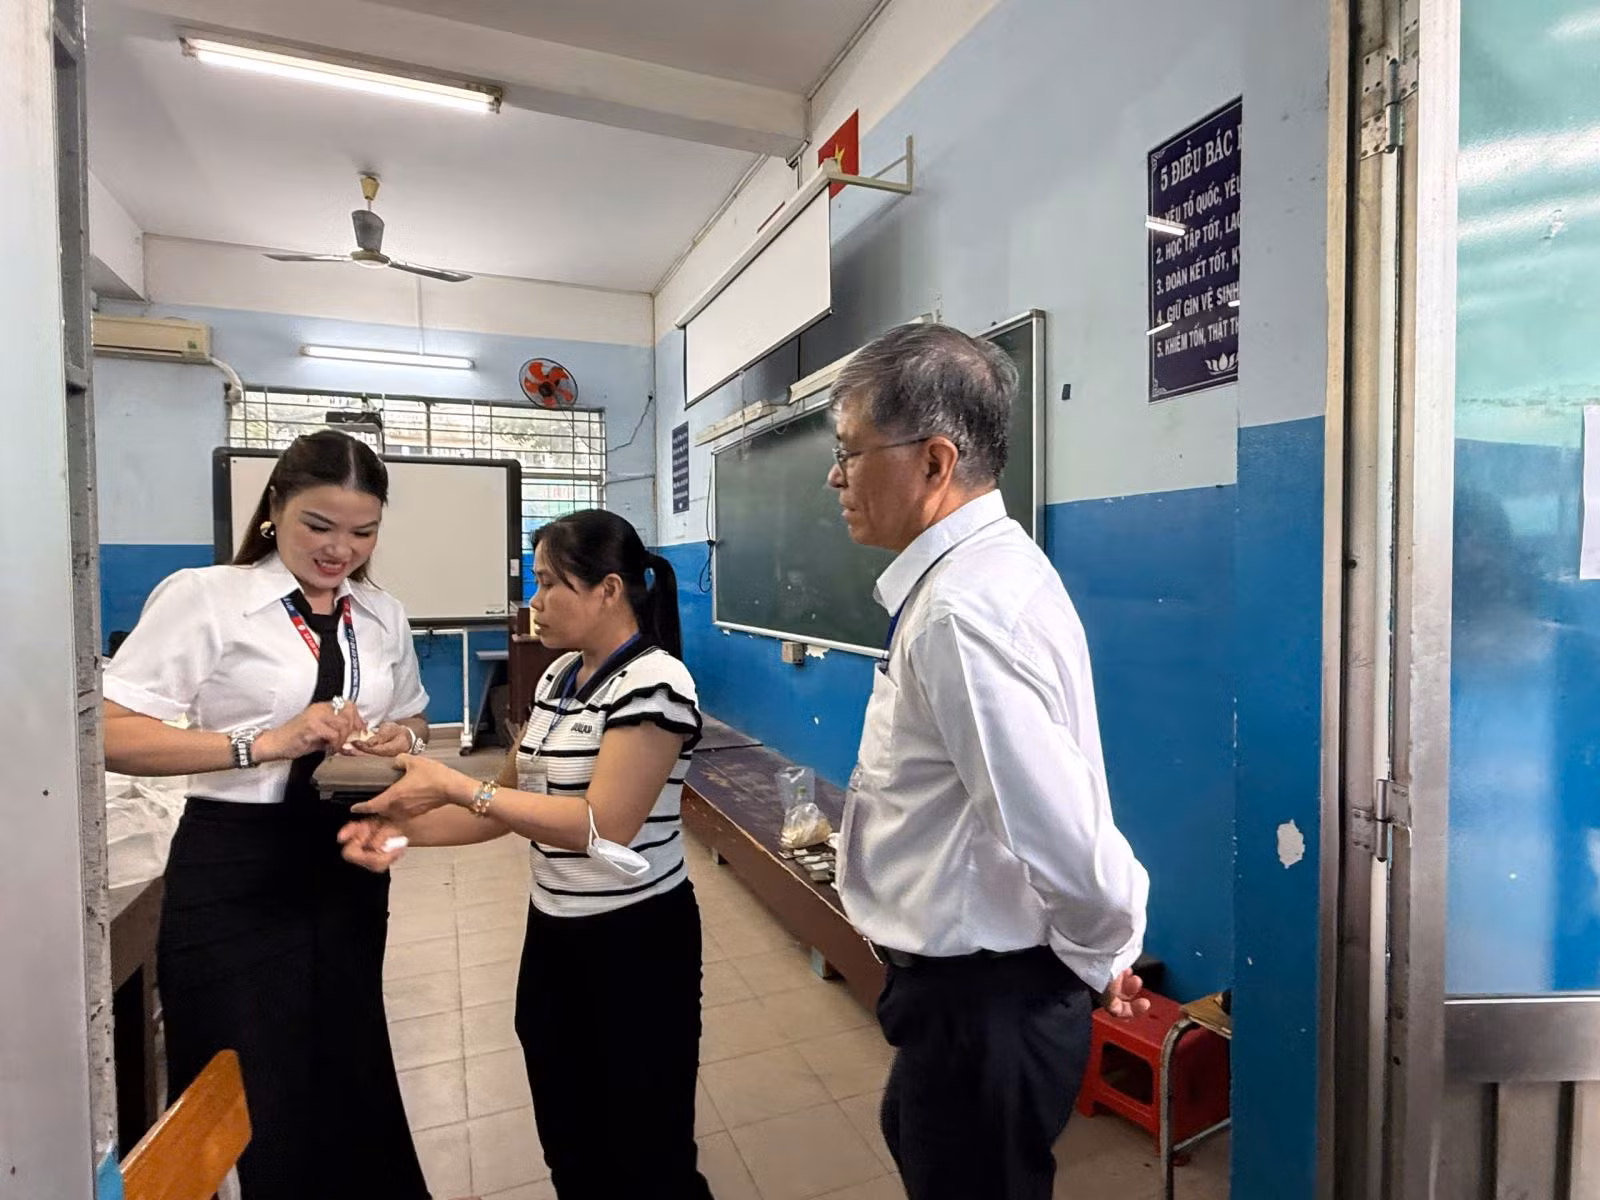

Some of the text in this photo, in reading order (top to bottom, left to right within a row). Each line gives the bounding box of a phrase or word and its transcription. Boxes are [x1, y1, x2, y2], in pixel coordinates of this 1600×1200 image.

[1160, 165, 1168, 192] 5
[1171, 139, 1202, 187] ĐIỀU
[1205, 128, 1233, 168] BÁC
[1183, 189, 1194, 219] TỔ
[1196, 181, 1222, 214] QUỐC,
[1156, 247, 1164, 265] 2.
[1165, 238, 1182, 261] HỌC
[1184, 227, 1201, 253] TẬP
[1202, 215, 1223, 244] TỐT,
[1156, 279, 1164, 296] 3.
[1165, 266, 1188, 292] ĐOÀN
[1189, 255, 1207, 283] KẾT
[1208, 246, 1229, 275] TỐT,
[1156, 310, 1165, 325] 4.
[1166, 299, 1182, 323] GIỮ
[1183, 294, 1199, 317] GÌN
[1201, 286, 1214, 312] VỆ
[1156, 341, 1164, 358] 5.
[1165, 331, 1188, 356] KHIÊM
[1208, 316, 1228, 343] THẬT
